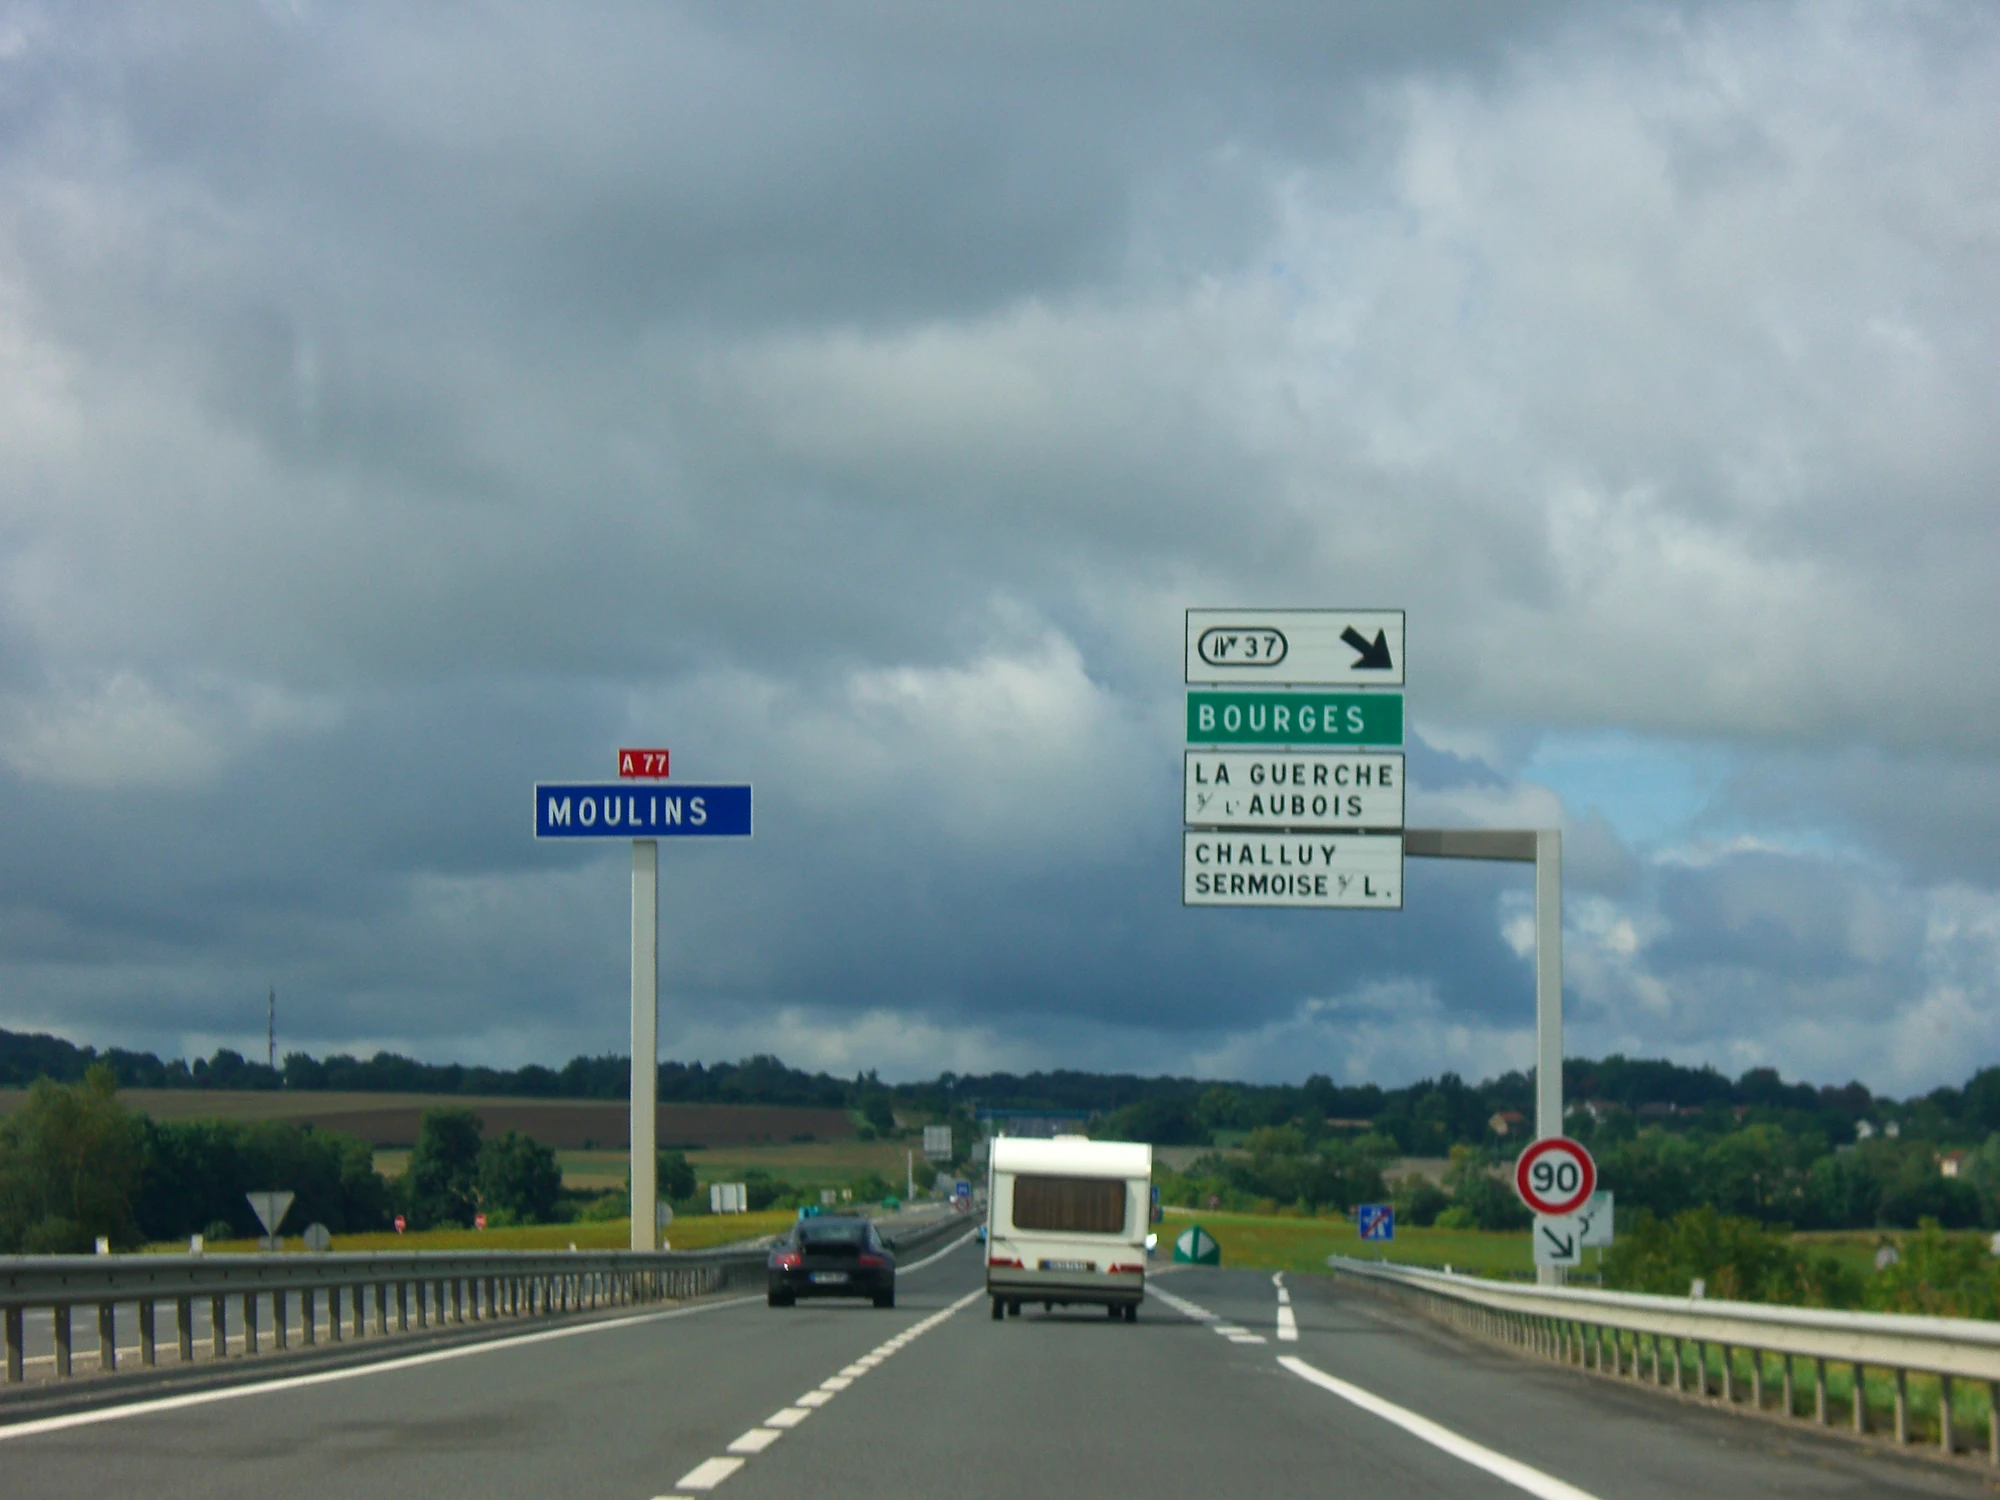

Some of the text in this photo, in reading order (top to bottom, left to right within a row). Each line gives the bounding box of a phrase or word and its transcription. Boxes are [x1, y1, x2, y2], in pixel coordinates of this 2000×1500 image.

[1245, 636, 1277, 658] 37
[1199, 704, 1365, 734] BOURGES
[622, 754, 667, 773] A 77
[1196, 763, 1394, 786] LA GUERCHE
[548, 797, 707, 826] MOULINS
[1196, 843, 1336, 866] CHALLUY
[1196, 873, 1328, 896] SERMOISE
[1364, 876, 1392, 898] L.
[1533, 1162, 1578, 1192] 90
